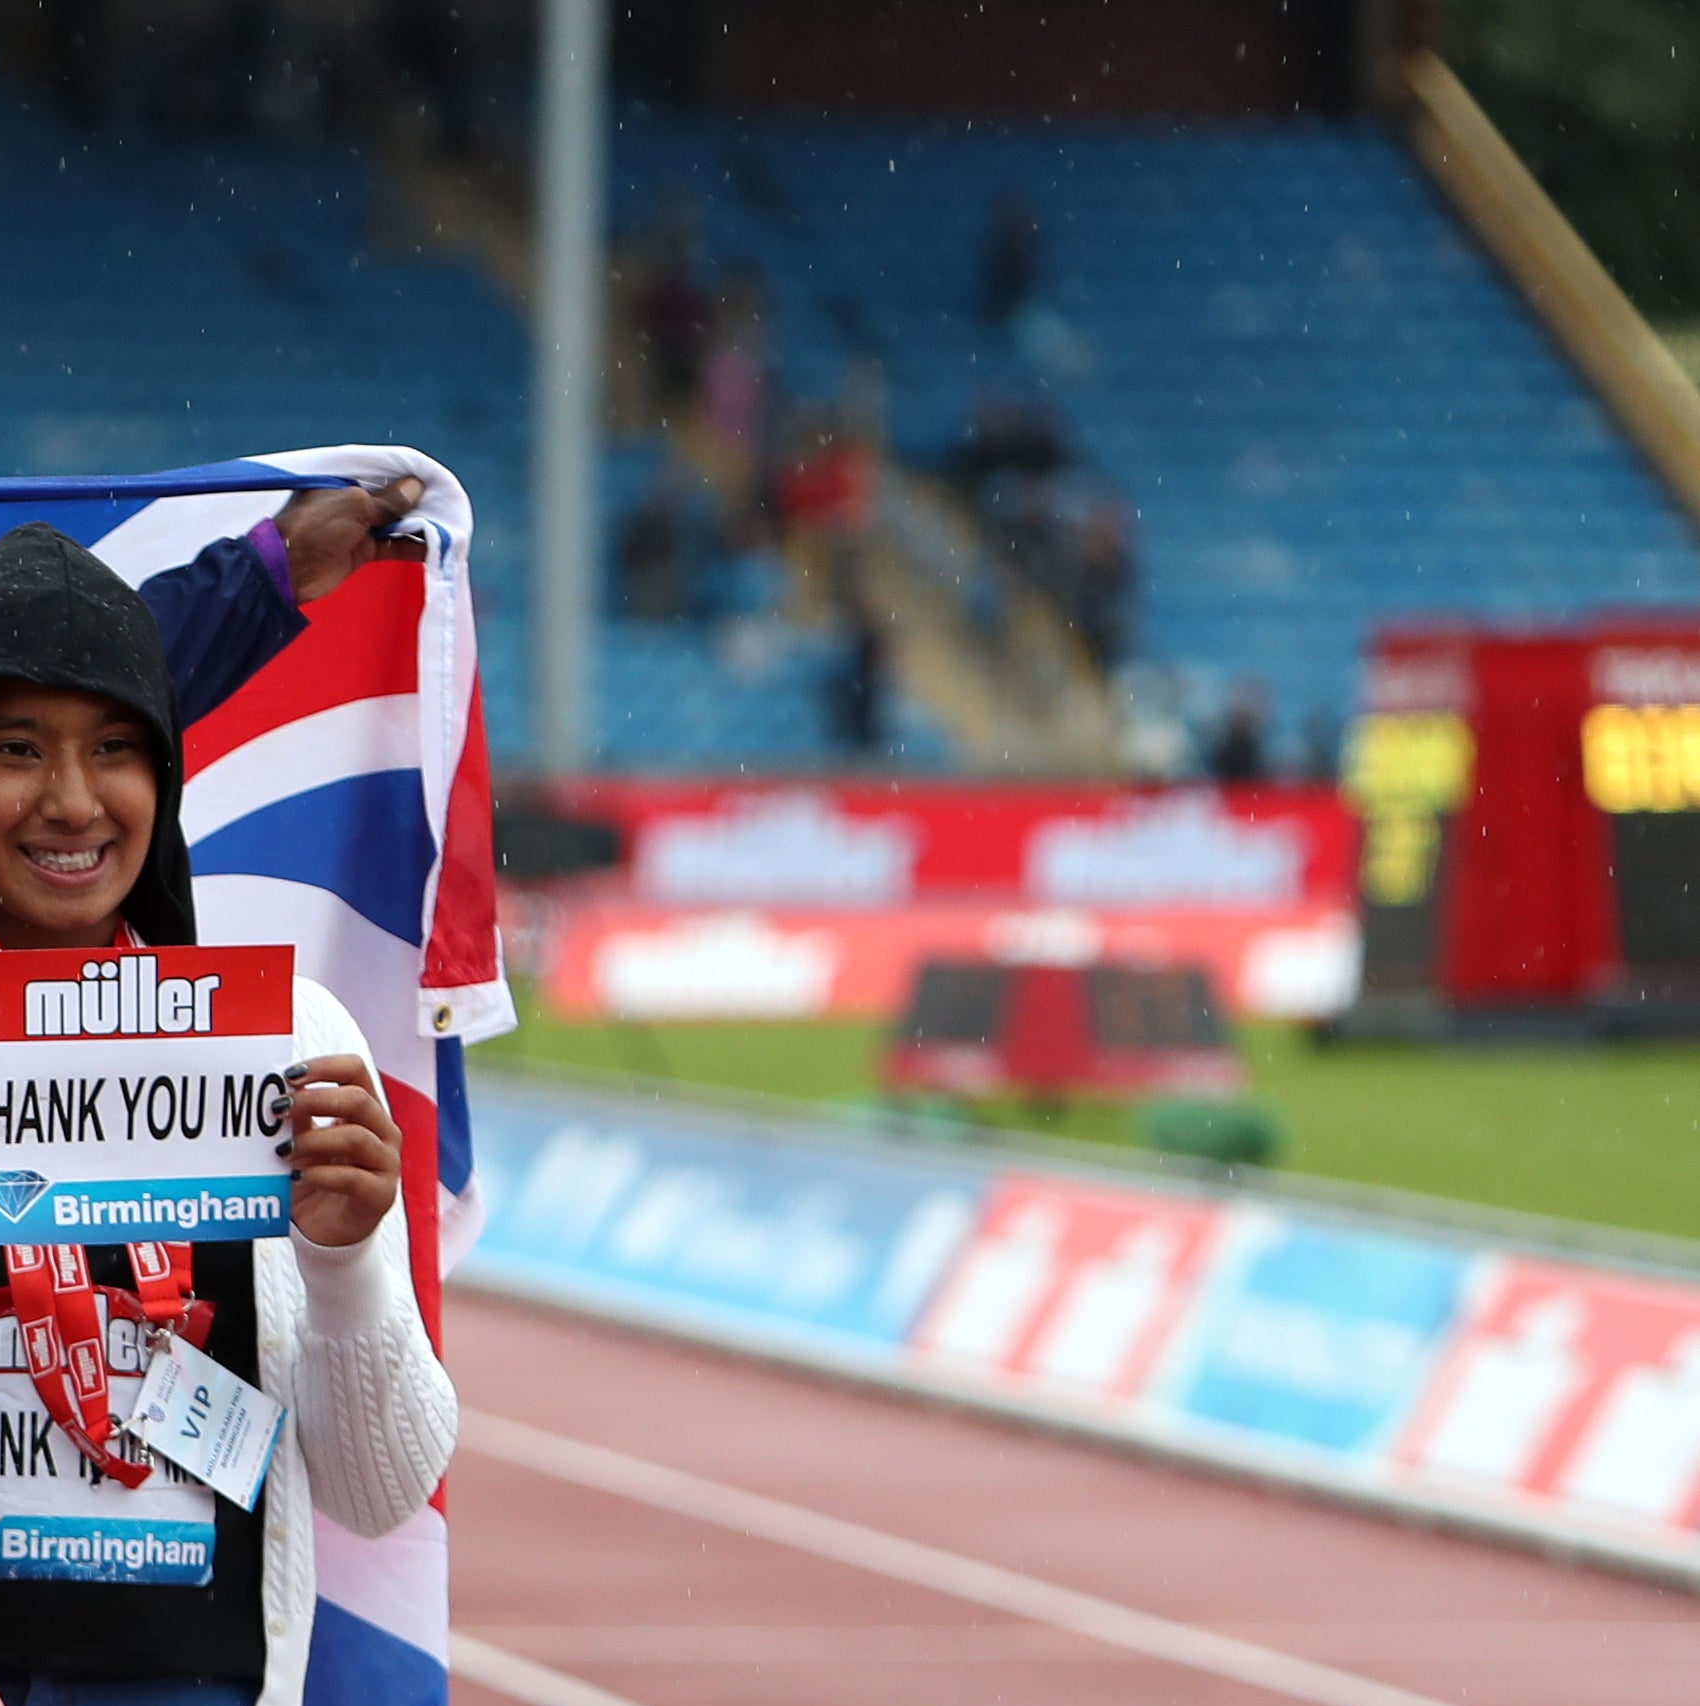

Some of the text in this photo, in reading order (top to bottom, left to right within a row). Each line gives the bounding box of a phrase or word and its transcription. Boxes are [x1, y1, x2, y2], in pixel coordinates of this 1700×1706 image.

[24, 954, 221, 1037] müller
[118, 1074, 205, 1141] YOU
[222, 1072, 287, 1138] MO
[53, 1191, 282, 1230] Birmingham
[179, 1384, 213, 1440] VIP
[1, 1527, 207, 1570] Birmingham
